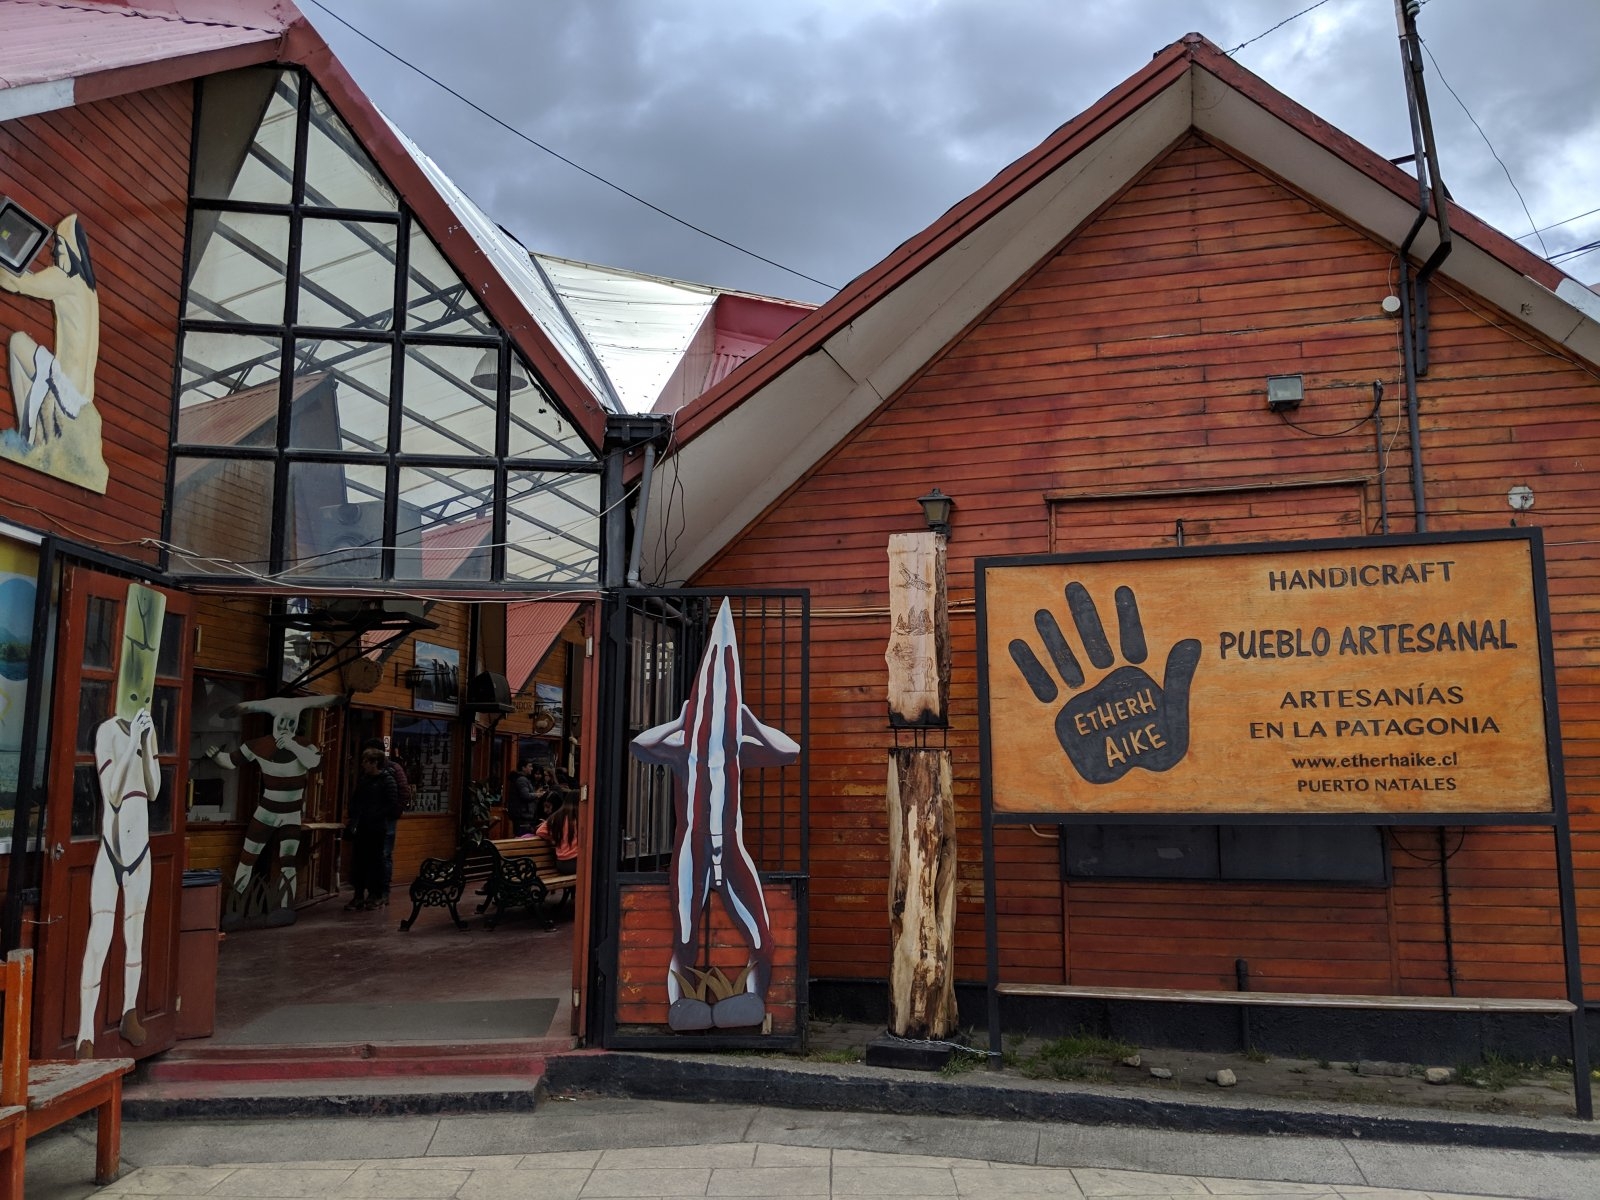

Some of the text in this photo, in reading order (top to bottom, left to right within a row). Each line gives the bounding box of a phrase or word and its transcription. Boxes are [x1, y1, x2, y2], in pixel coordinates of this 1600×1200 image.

[1269, 561, 1455, 591] HANDICRAFT
[1219, 619, 1518, 660] PUEBLO ARTESANAL
[1280, 683, 1464, 709] ARTESANÍAS
[1073, 688, 1157, 736] ETHERH
[1250, 716, 1500, 739] EN LA PATAGONIA
[1105, 723, 1167, 768] AIKE
[1291, 752, 1458, 769] www.etherhaike.cl
[1297, 777, 1457, 793] PUERTO NATALES
